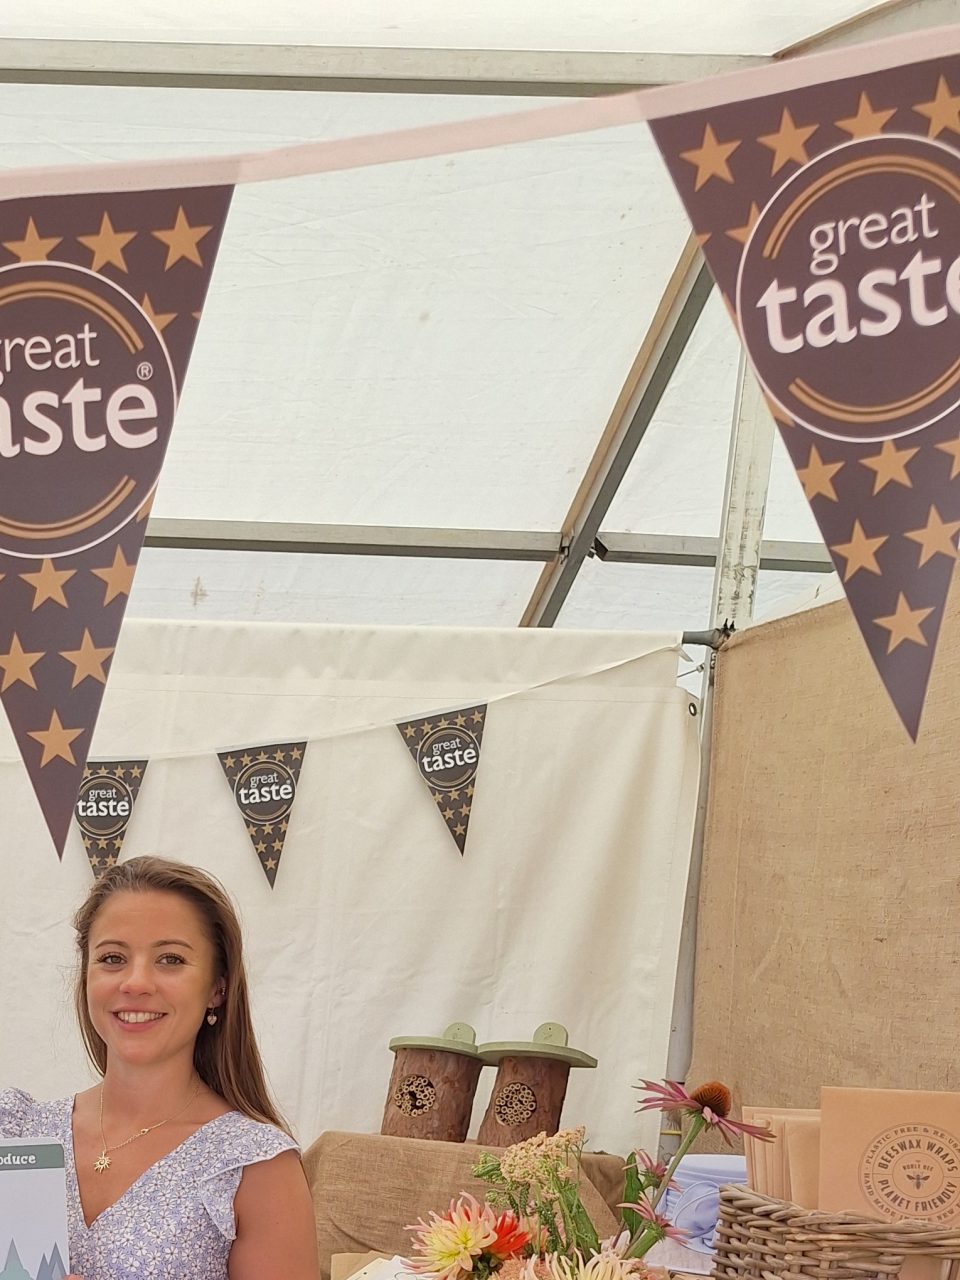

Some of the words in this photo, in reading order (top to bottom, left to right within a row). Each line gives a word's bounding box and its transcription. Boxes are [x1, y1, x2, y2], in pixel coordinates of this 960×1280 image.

[809, 193, 939, 276] great
[432, 737, 461, 755] great
[422, 748, 477, 772] taste
[250, 772, 279, 788] great
[88, 788, 117, 801] great
[239, 784, 293, 804] taste
[76, 798, 130, 817] taste
[865, 1133, 892, 1165] PLASTIC
[878, 1139, 922, 1170] BEESWAX
[926, 1141, 958, 1172] WRAPS
[878, 1179, 911, 1210] PLANET
[914, 1181, 958, 1212] FRIENDLY
